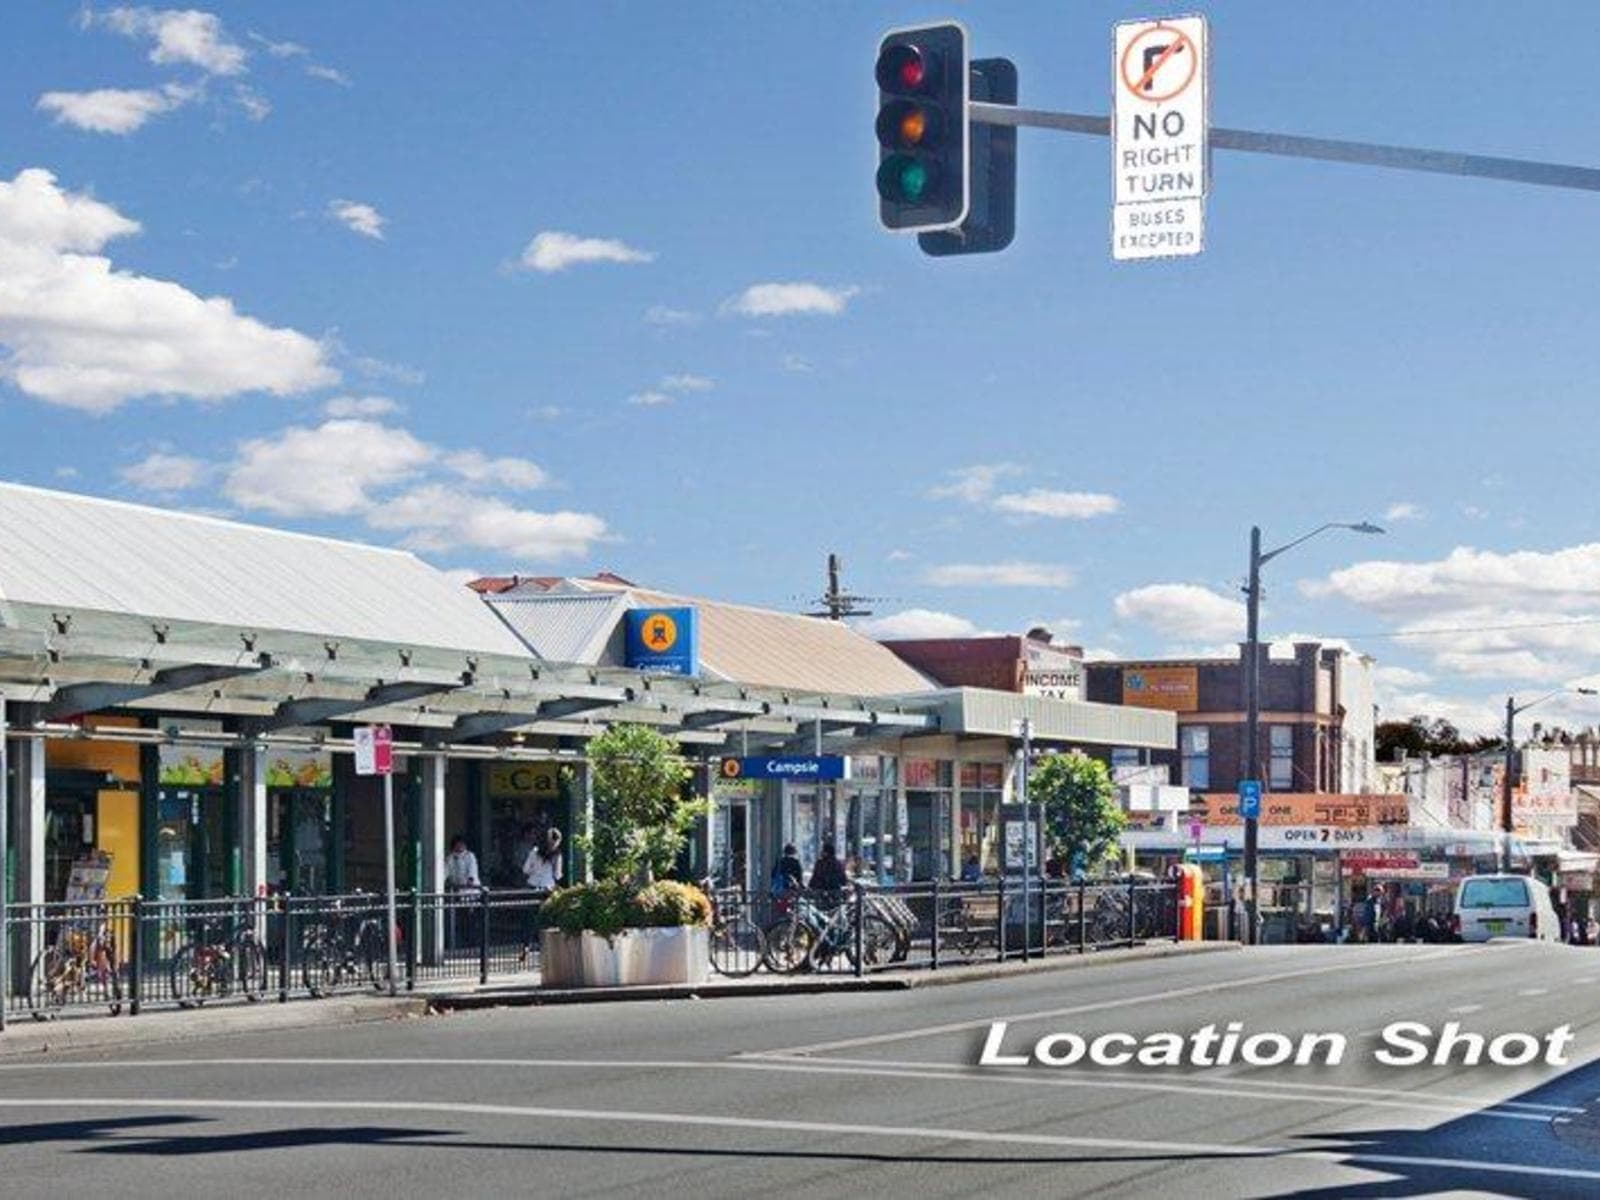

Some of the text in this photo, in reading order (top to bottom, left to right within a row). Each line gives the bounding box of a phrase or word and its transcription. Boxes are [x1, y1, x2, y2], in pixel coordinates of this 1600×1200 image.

[1133, 110, 1185, 140] NO
[1122, 144, 1196, 169] RIGHT
[1126, 172, 1194, 193] TURN
[1129, 208, 1185, 227] BUSES
[1120, 232, 1194, 249] EXCEPTED
[1025, 673, 1080, 686] INCOME
[766, 761, 819, 774] Campsie
[1284, 829, 1364, 842] OPEN 7 DAYS
